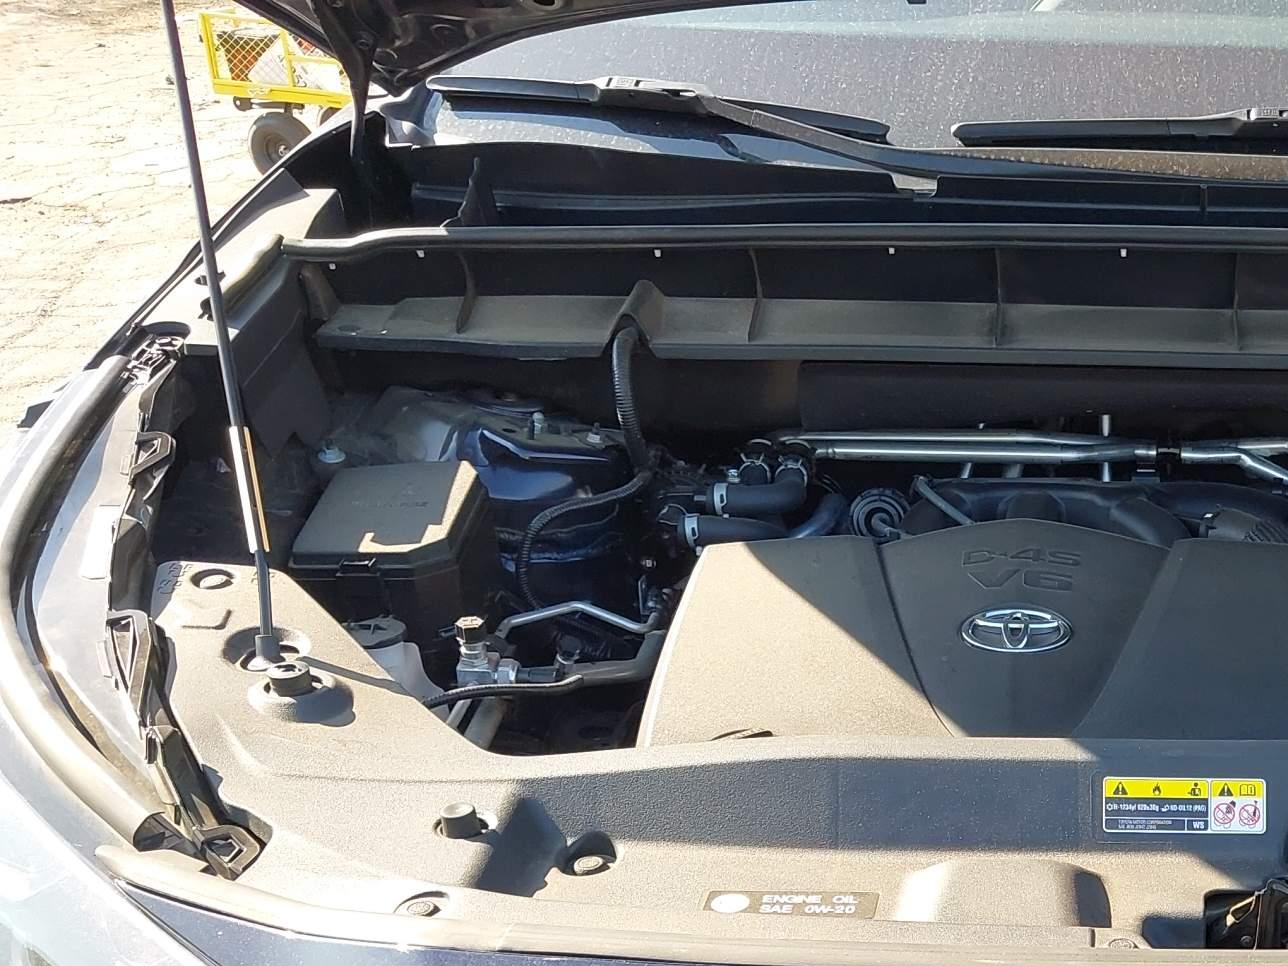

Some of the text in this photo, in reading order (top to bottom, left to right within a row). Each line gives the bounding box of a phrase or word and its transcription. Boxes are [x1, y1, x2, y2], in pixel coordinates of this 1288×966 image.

[962, 547, 1082, 567] D-4S
[967, 568, 1074, 592] V6
[1192, 821, 1205, 829] WS
[762, 894, 859, 904] ENGINE OIL
[759, 904, 856, 914] SAE 0W-20
